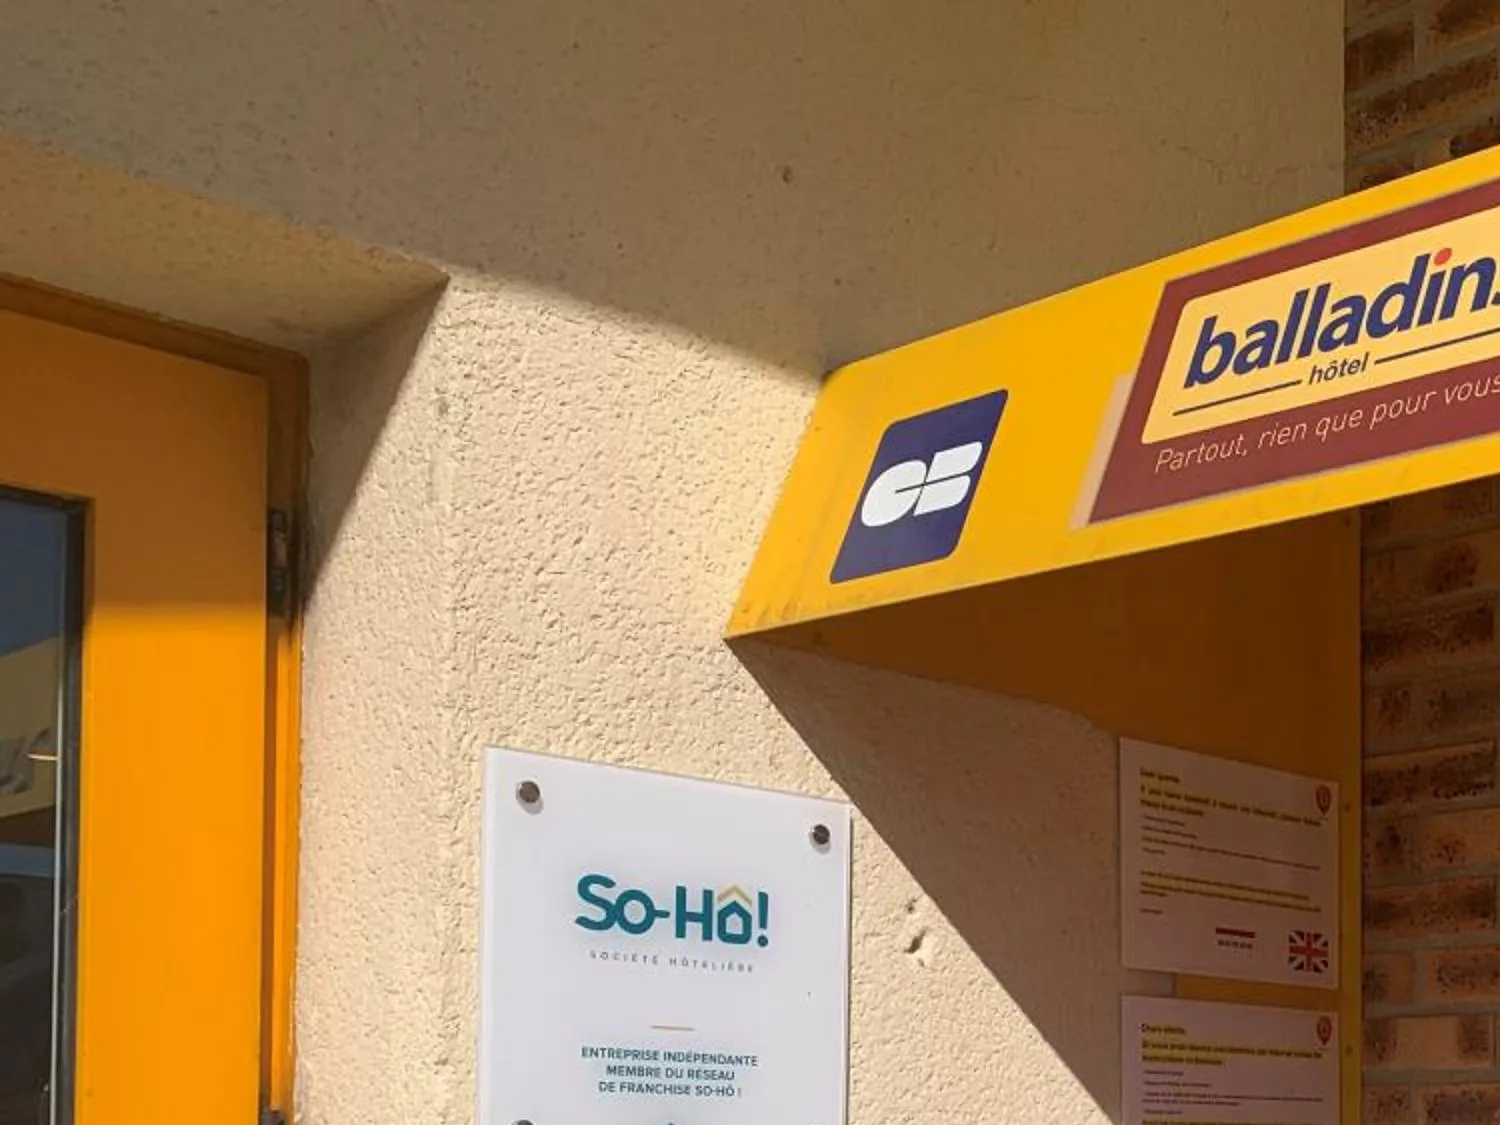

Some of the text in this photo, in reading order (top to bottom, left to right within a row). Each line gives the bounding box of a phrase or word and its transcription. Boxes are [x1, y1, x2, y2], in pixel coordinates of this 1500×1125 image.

[1307, 351, 1369, 386] hôtel
[1154, 434, 1248, 474] Partout,
[1257, 419, 1308, 450] rien
[1315, 408, 1364, 442] que
[1370, 388, 1437, 430] pour
[581, 1046, 758, 1067] ENTREPRISE INDÉPENDANTE
[606, 1065, 661, 1079] MEMBRE
[665, 1068, 683, 1079] DU
[599, 1081, 616, 1093] DE
[619, 1082, 691, 1096] FRANCHISE
